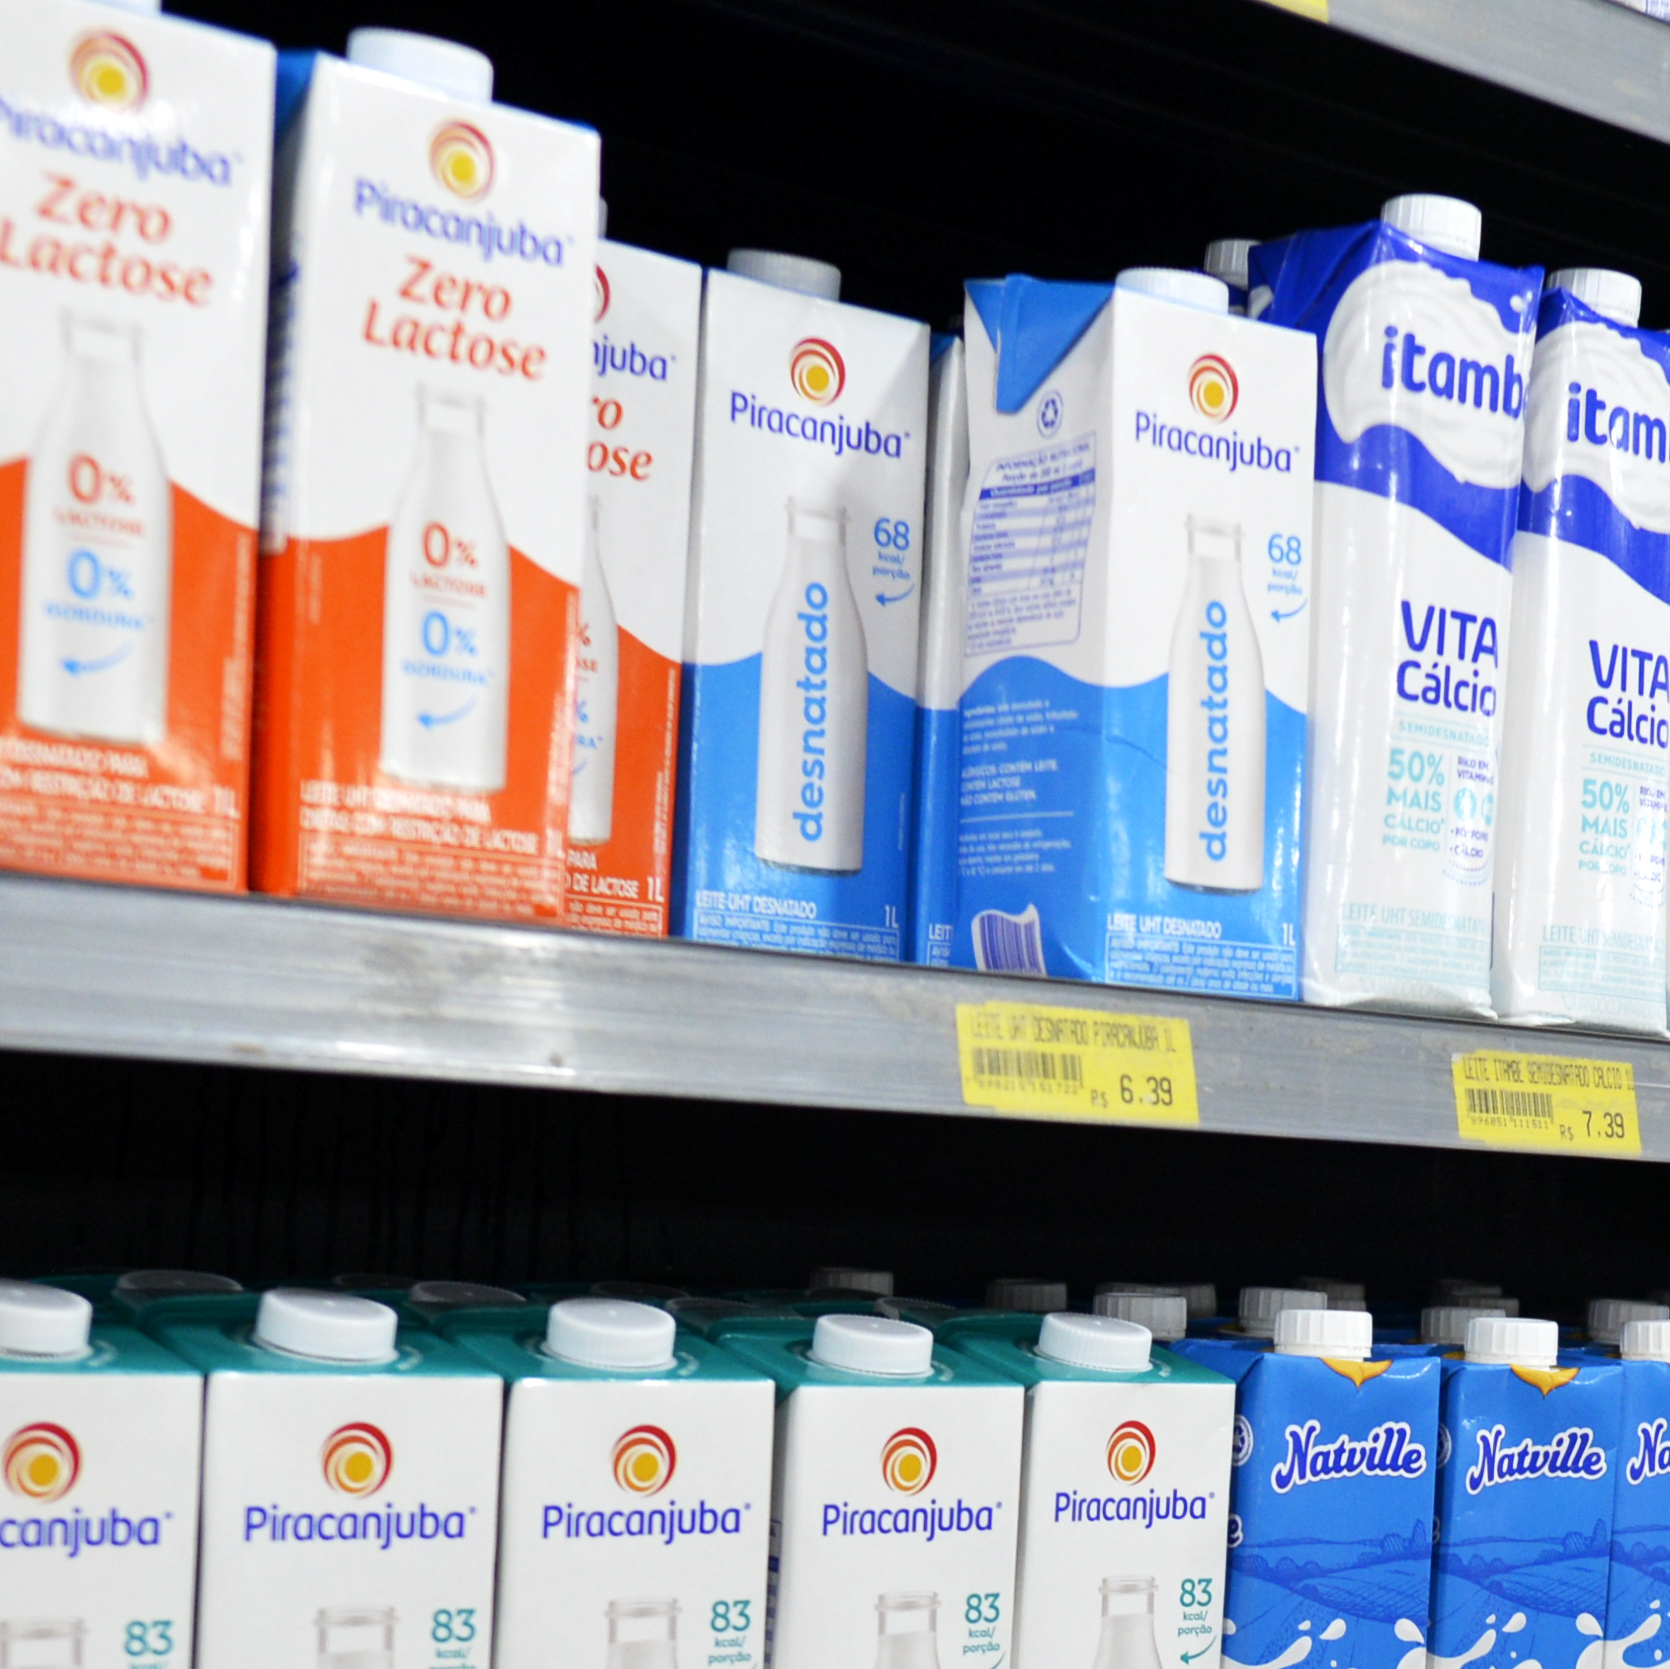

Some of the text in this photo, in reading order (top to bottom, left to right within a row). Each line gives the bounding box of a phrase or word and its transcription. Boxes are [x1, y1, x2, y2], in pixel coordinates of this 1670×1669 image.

[35, 172, 173, 244] Zero
[353, 177, 564, 268] Piracanjuba
[397, 256, 512, 321] Zero
[362, 300, 547, 381] Lactose
[1381, 326, 1525, 418] itamb
[730, 393, 902, 459] Piracanjuba
[1134, 411, 1292, 474] Piracanjuba
[69, 454, 135, 506] 0%
[422, 521, 479, 568] 0%
[873, 519, 911, 550] 68
[1267, 534, 1302, 566] 68
[66, 548, 133, 602] 0%
[420, 610, 479, 656] 0%
[1399, 600, 1498, 670] VITA
[1397, 657, 1497, 720] Cálcio
[1588, 637, 1670, 702] VITA
[800, 581, 828, 842] desnatado
[1199, 600, 1227, 861] desnatado
[1586, 696, 1669, 749] Cálcio
[1387, 748, 1445, 787] 50%
[1386, 787, 1443, 813] MAIS
[1581, 778, 1630, 813] 50%
[1581, 813, 1628, 839] MAIS
[753, 895, 817, 919] DESNATADO
[1163, 918, 1222, 939] DESNATADO
[1119, 1074, 1173, 1107] 6.39
[1493, 1058, 1523, 1085] ITAMBE
[1581, 1110, 1626, 1139] 7.39
[1271, 1420, 1427, 1494] Natville
[1465, 1422, 1607, 1495] Natville
[244, 1501, 467, 1549] Piracanjuba
[542, 1502, 742, 1545] Piracanjuba
[821, 1500, 994, 1543] Piracanjuba
[1053, 1487, 1208, 1529] Piracanjuba
[964, 1593, 1001, 1626] 83
[1178, 1577, 1213, 1608] 83
[124, 1619, 173, 1656] 83
[430, 1608, 477, 1644] 83
[708, 1599, 751, 1633] 83
